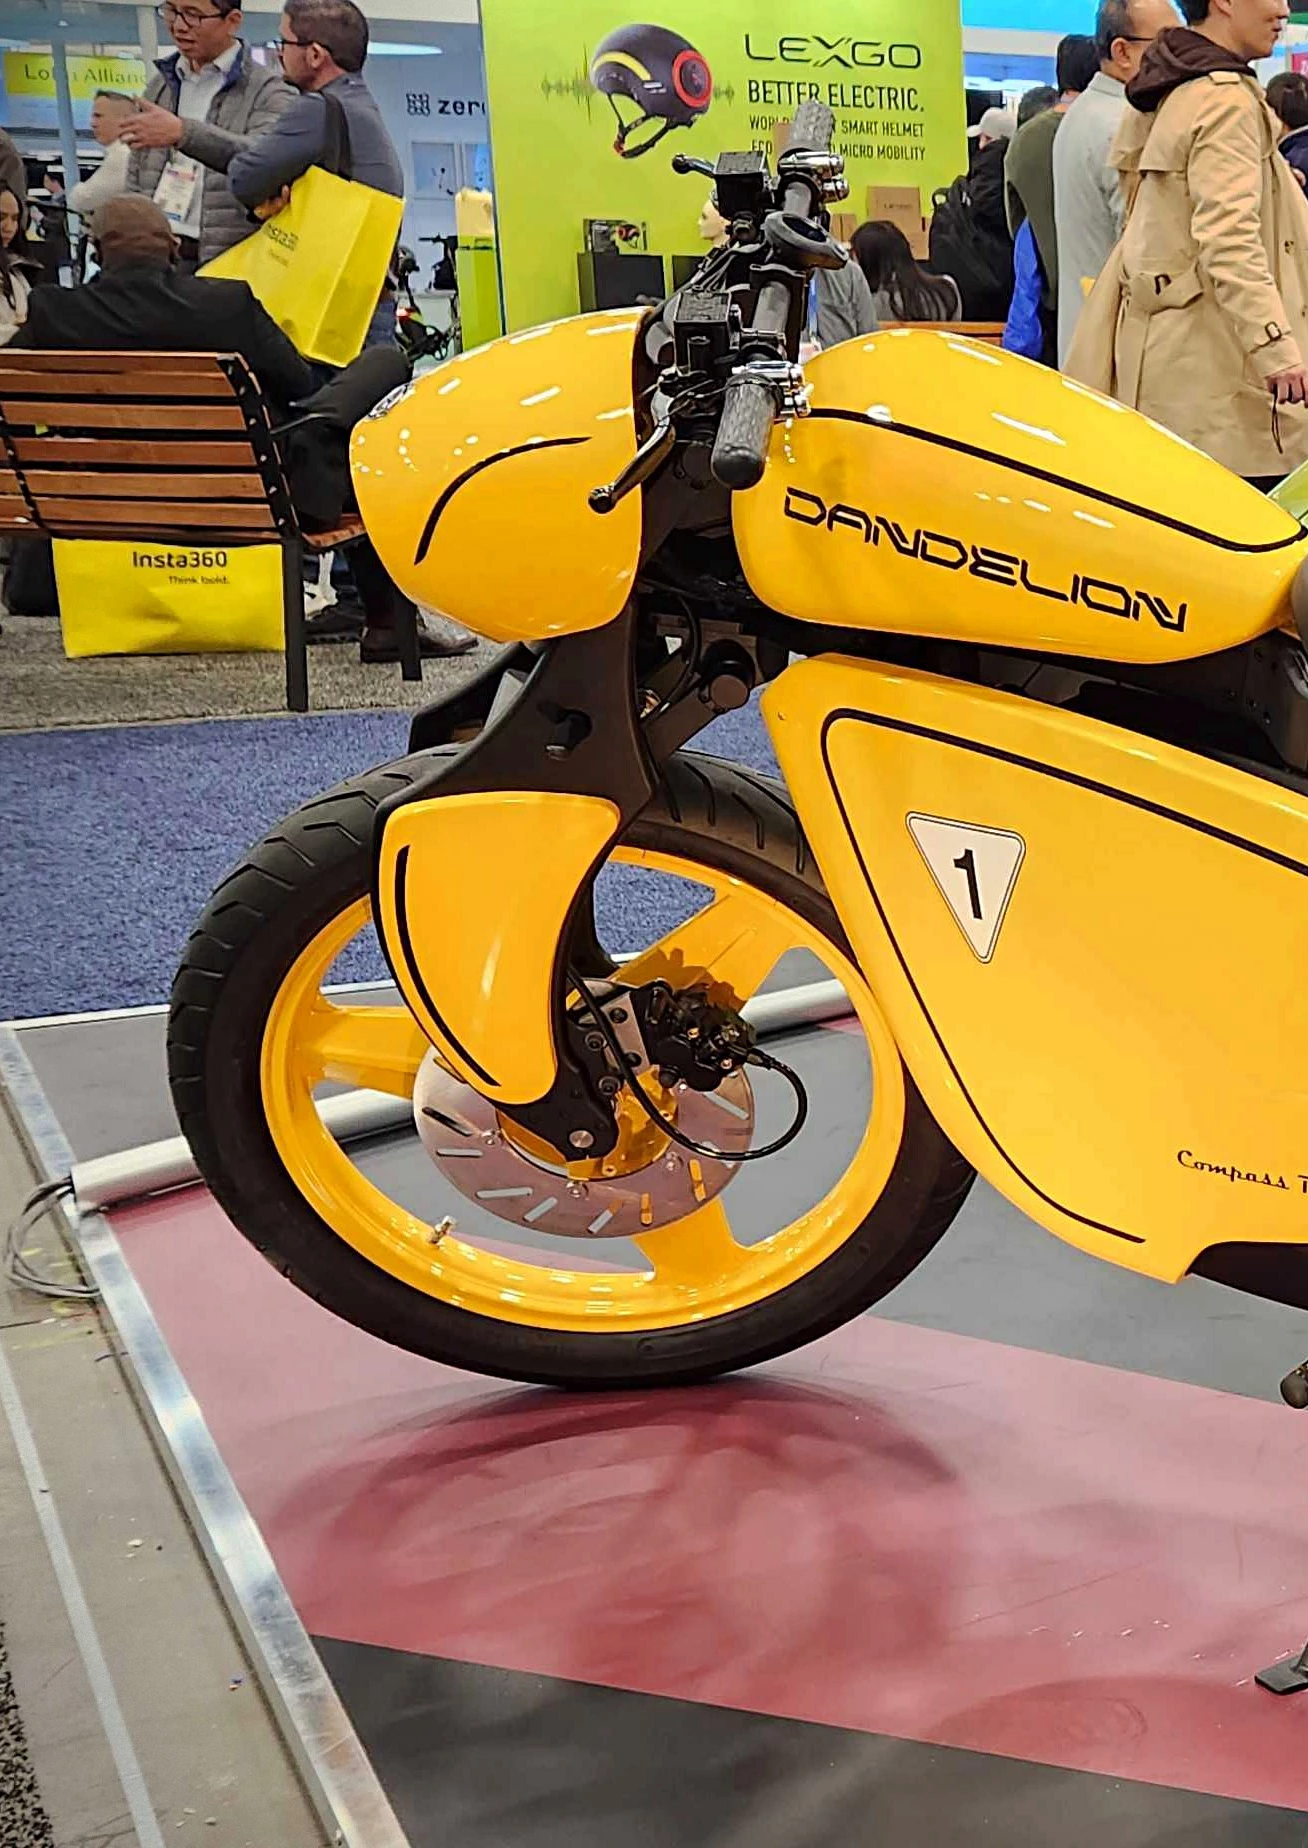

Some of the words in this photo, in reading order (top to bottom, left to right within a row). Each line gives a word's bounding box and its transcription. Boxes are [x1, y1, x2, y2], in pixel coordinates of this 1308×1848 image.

[745, 34, 922, 69] LEXGO
[438, 99, 486, 116] zer
[748, 79, 820, 105] BETTER
[828, 83, 925, 112] ELECTRIC.
[841, 119, 879, 136] SMART
[882, 120, 924, 138] HELMET
[840, 143, 875, 159] MICRO
[876, 145, 926, 161] MOBILITY
[132, 551, 228, 569] Insta360
[783, 486, 1188, 633] DANDELION
[953, 848, 983, 920] 1
[1177, 1150, 1290, 1190] Compass
